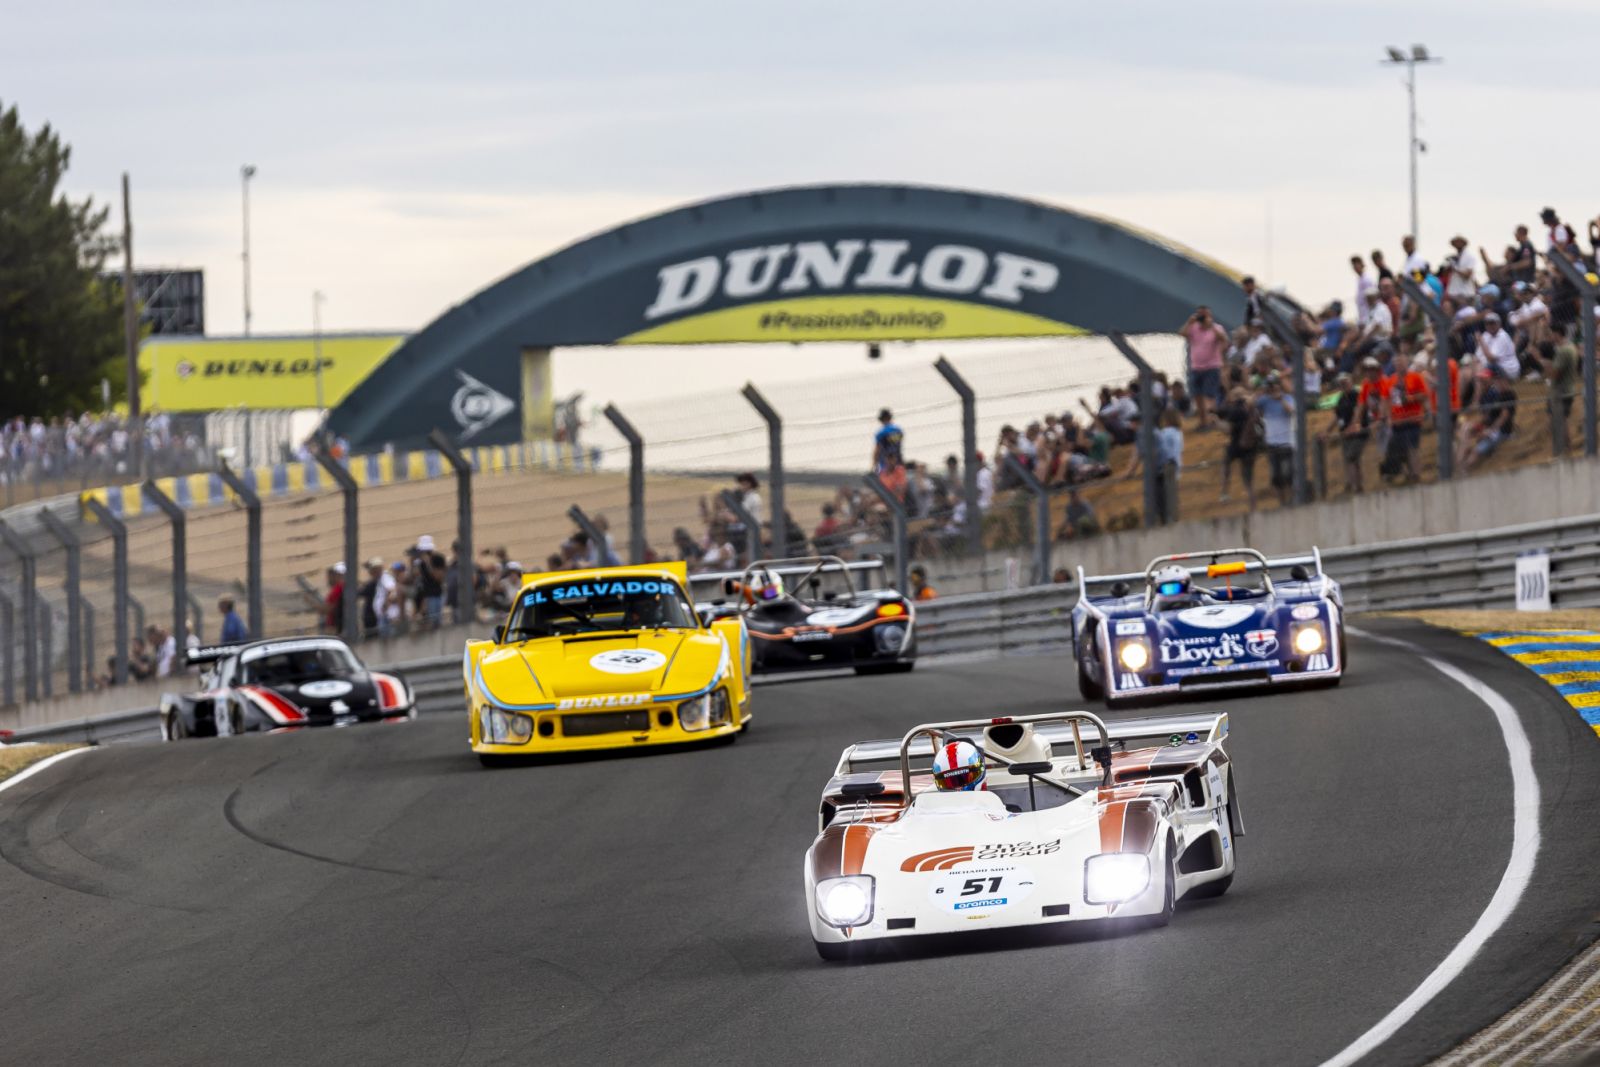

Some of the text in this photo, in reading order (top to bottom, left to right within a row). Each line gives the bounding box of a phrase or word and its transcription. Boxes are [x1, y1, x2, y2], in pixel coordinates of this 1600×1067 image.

[645, 239, 1059, 319] DUNLOP
[759, 309, 945, 330] #PassionDunlop
[204, 357, 334, 376] DUNLOP
[523, 581, 675, 606] EL SALVADOR
[1159, 637, 1245, 667] Lloyd's
[557, 693, 651, 710] DUNLOP
[977, 846, 1061, 860] Group
[960, 876, 1003, 896] 51
[958, 898, 1004, 909] aramco
